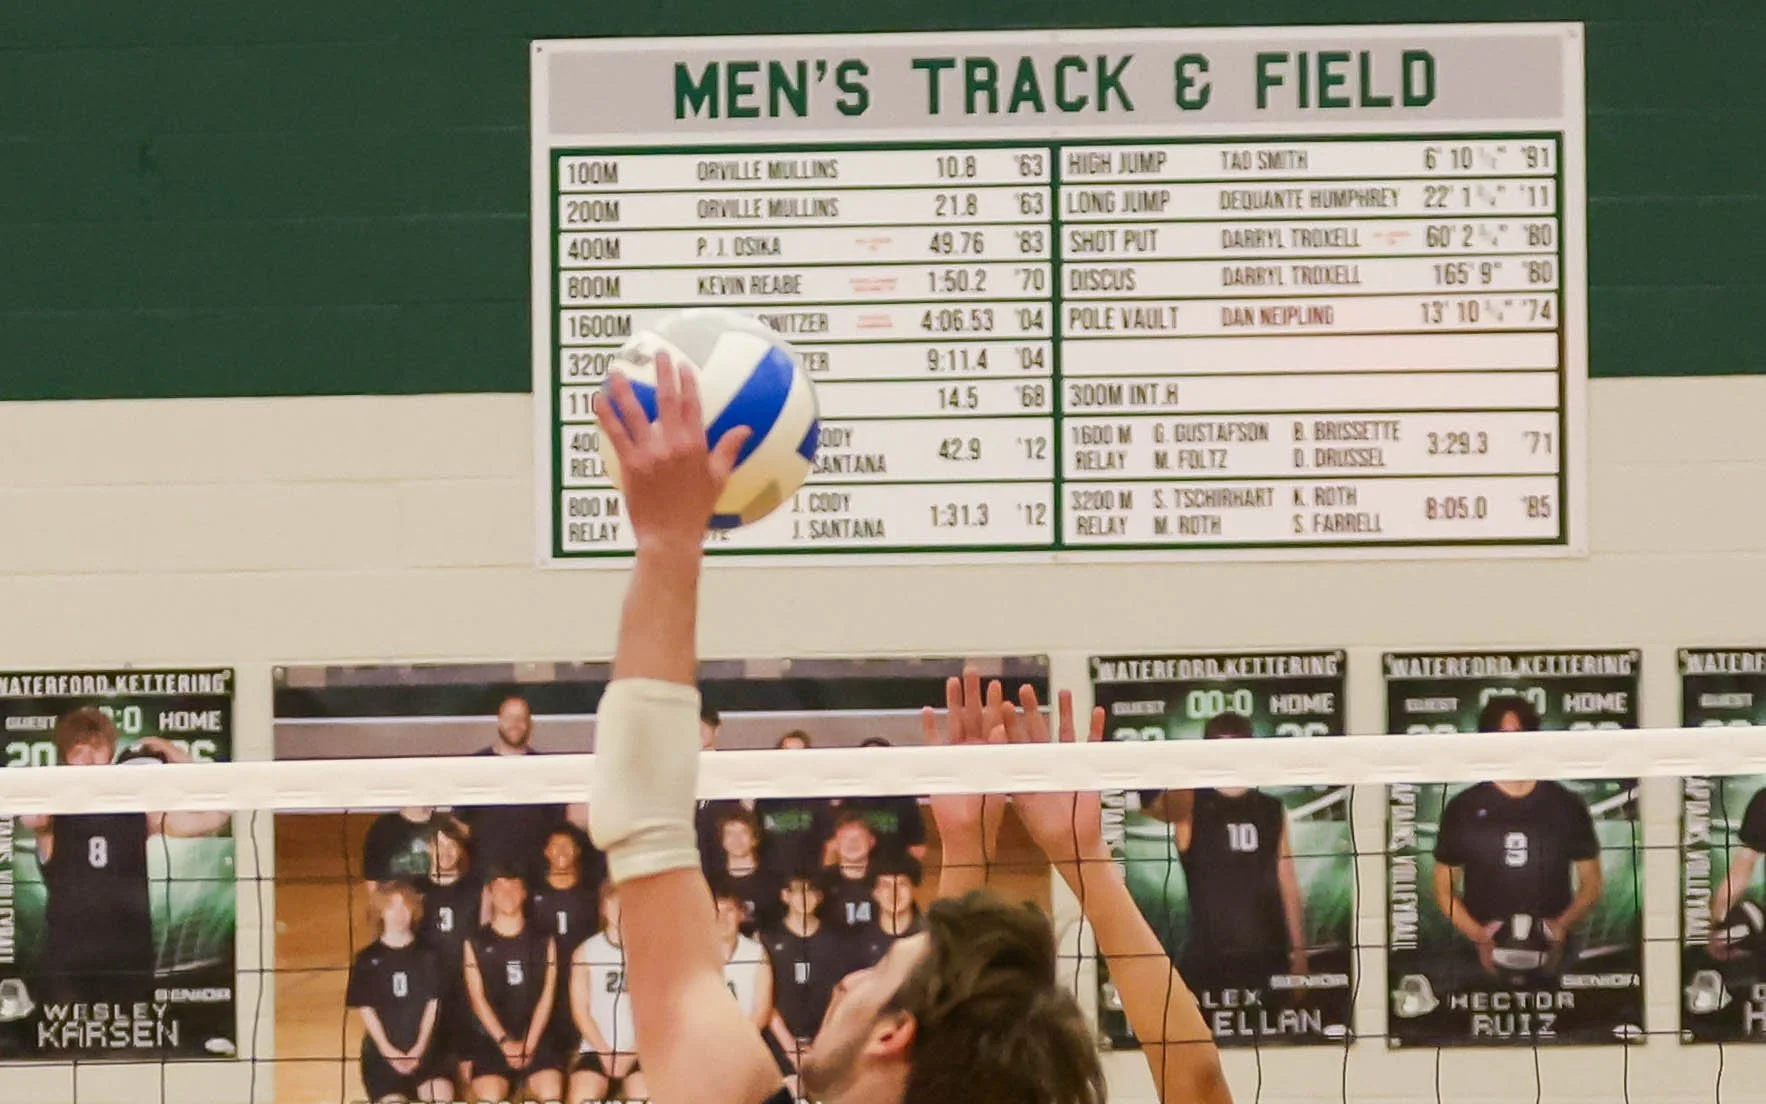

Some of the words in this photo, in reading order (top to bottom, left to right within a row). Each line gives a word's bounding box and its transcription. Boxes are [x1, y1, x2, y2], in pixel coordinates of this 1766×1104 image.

[674, 58, 870, 118] MEN'S
[912, 53, 1134, 114] TRACK
[1175, 52, 1211, 110] &
[1256, 49, 1435, 108] FIELD
[568, 162, 618, 184] 100M
[697, 161, 762, 181] ORVILLE
[768, 159, 838, 179] MULLINS
[936, 155, 976, 178] 10.8
[1068, 152, 1111, 175] HIGH
[1118, 151, 1168, 174] JUMP
[1257, 150, 1308, 170] SMITH
[1451, 146, 1473, 170] 10
[567, 201, 619, 223] 200M
[697, 199, 762, 219] ORVILLE
[768, 198, 839, 218] MULLINS
[935, 193, 977, 217] 21.8
[1068, 191, 1115, 214] LONG
[1121, 190, 1170, 213] JUMP
[1310, 188, 1400, 208] HUMPHREY
[567, 238, 620, 260] 400M
[929, 231, 984, 254] 49.76
[1071, 229, 1117, 252] SHOT
[1123, 228, 1159, 251] PUT
[1221, 228, 1285, 248] DARRYL
[1291, 227, 1361, 248] TROXELL
[567, 276, 620, 298] 800M
[697, 276, 745, 295] KEVIN
[1070, 268, 1136, 291] DISCUS
[1221, 266, 1284, 286] DARRYL
[1291, 265, 1362, 285] TROXELL
[569, 315, 631, 337] 1600M
[921, 308, 994, 331] 4:06.53
[1069, 307, 1115, 329] POLE
[1121, 306, 1178, 329] VAULT
[1221, 306, 1254, 327] DAN
[1457, 300, 1480, 322] 10
[569, 353, 614, 376] 320
[938, 386, 978, 409] 14.5
[1070, 384, 1123, 406] 300M
[813, 428, 853, 448] ODY
[1174, 422, 1270, 441] GUSTAFSON
[1314, 420, 1401, 441] BRISSETTE
[939, 437, 981, 460] 42.9
[1076, 451, 1127, 470] RELAY
[1178, 450, 1228, 469] FOLTZ
[812, 453, 887, 474] SANTANA
[808, 493, 851, 513] CODY
[1314, 487, 1357, 506] ROTH
[930, 503, 989, 527] 1:31.3
[1076, 516, 1127, 536] RELAY
[1178, 515, 1221, 534] ROTH
[1313, 513, 1383, 533] FARRELL
[569, 521, 618, 543] RELAY
[810, 518, 886, 540] SANTANA
[1101, 657, 1220, 681] WATERFORD
[1223, 654, 1337, 677] KETTERING
[1391, 657, 1514, 678] WATERFORD
[1518, 654, 1631, 676] KETTERING
[115, 672, 225, 695] KETTERING
[1269, 693, 1335, 716] HOME
[1563, 692, 1628, 714] HOME
[159, 710, 222, 732] HOME
[1227, 823, 1259, 852] 10
[87, 836, 109, 868] 8
[1202, 988, 1262, 1009] LEX
[1450, 991, 1575, 1010] HECTOR
[43, 1003, 168, 1021] WESLEY
[1213, 1009, 1322, 1037] ELLAN
[37, 1019, 180, 1048] KARSEN
[1472, 1013, 1558, 1038] RUIZ
